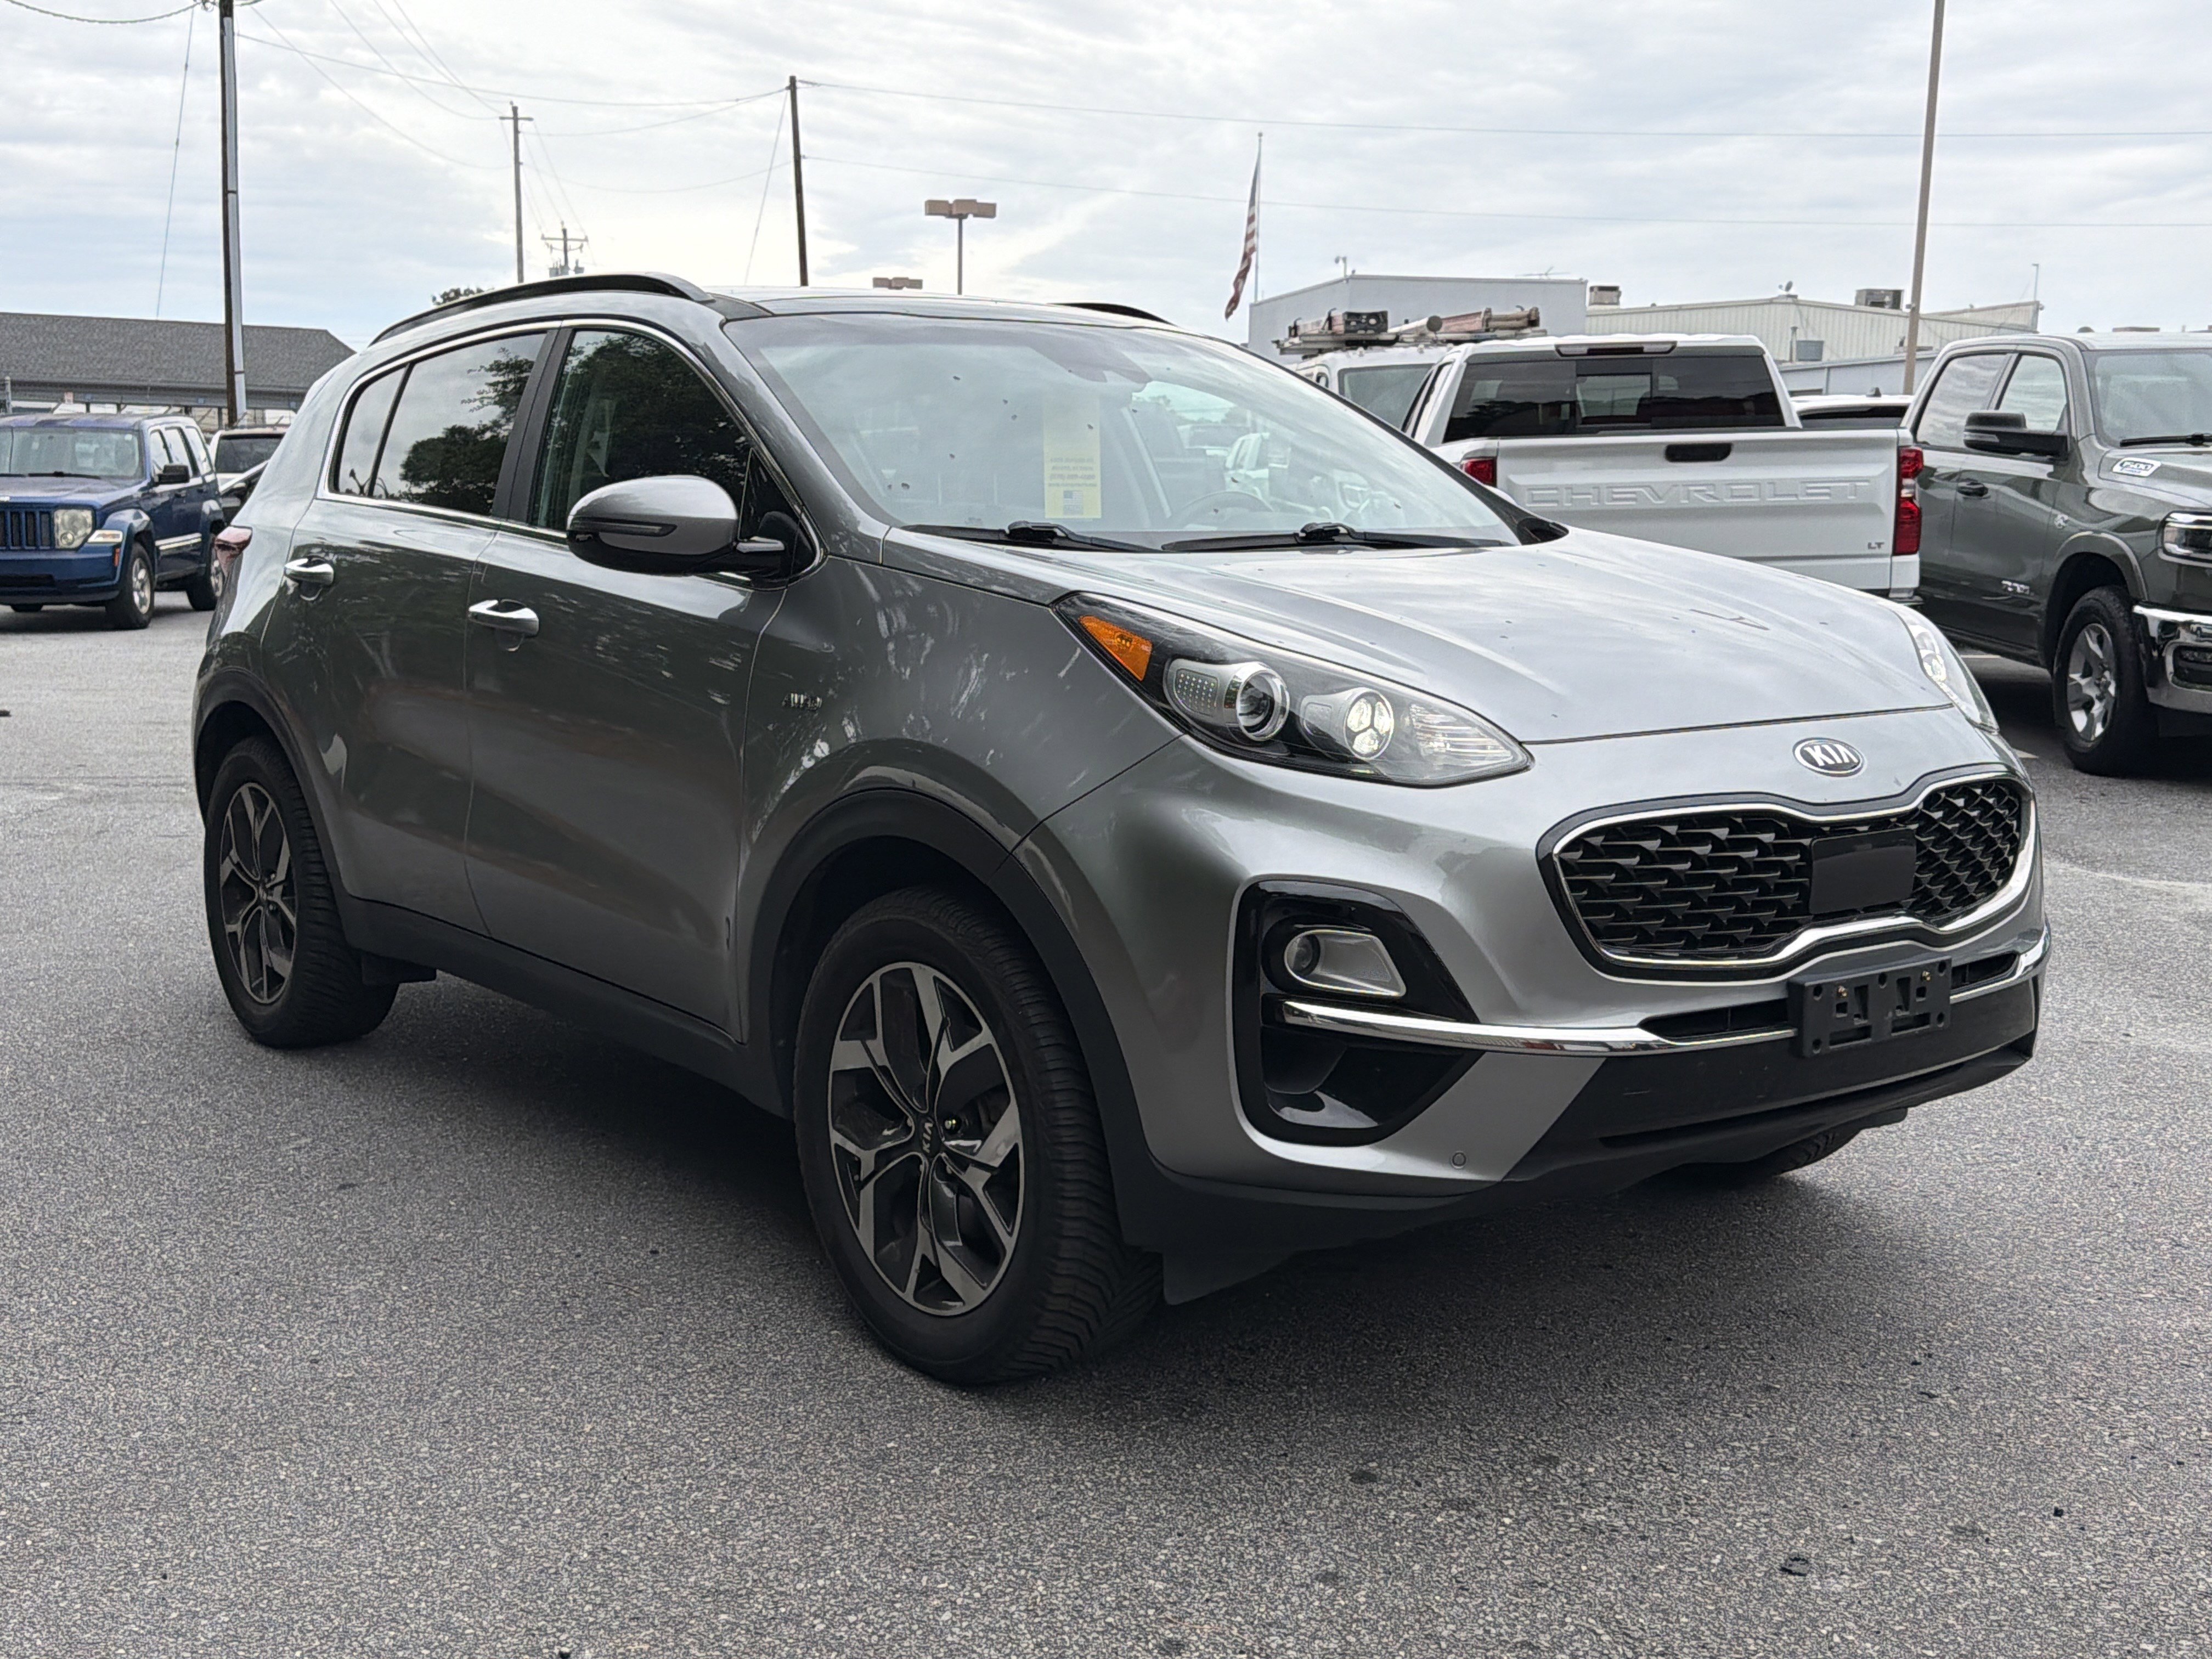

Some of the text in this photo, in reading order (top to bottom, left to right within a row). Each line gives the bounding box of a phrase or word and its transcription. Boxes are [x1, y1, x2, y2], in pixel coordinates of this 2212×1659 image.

[1526, 479, 1870, 507] CHEVROLET
[1803, 743, 1859, 766] KIA
[922, 1122, 933, 1153] KIA
